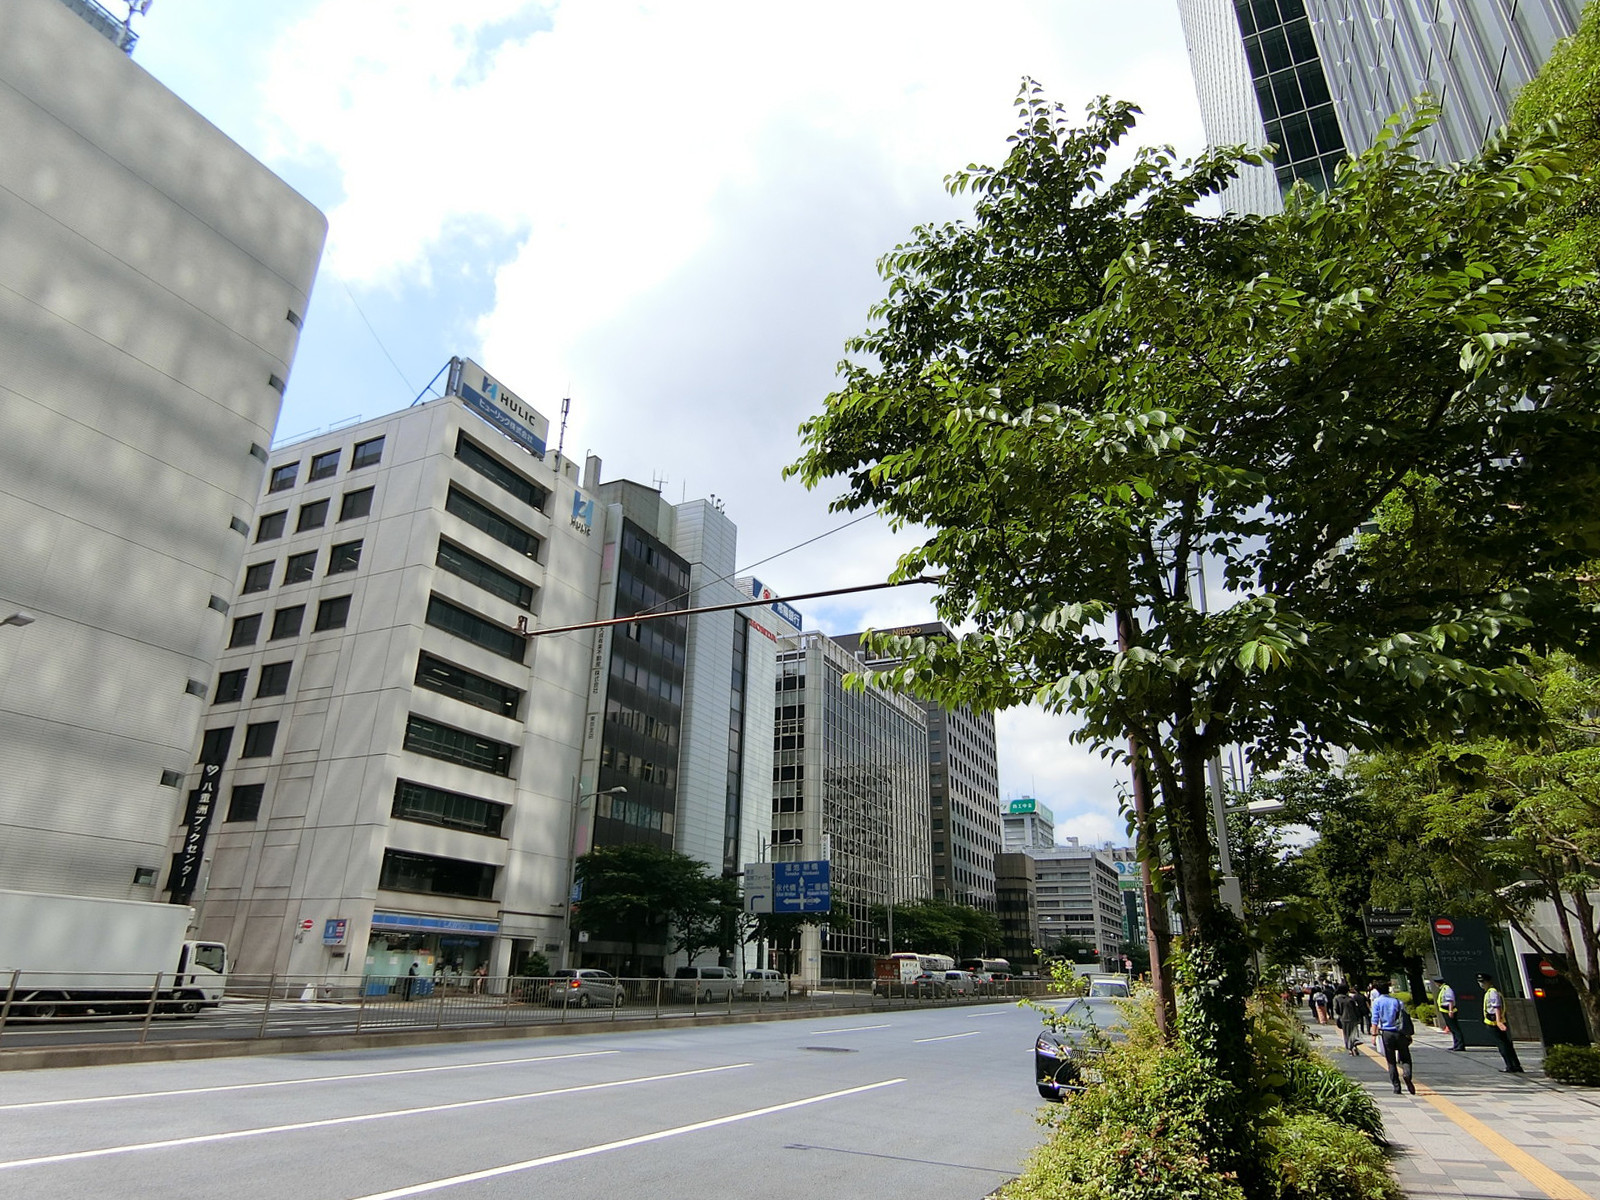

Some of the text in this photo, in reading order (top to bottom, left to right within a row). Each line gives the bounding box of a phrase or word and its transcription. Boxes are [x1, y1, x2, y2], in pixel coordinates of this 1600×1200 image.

[479, 399, 534, 443] ヒューリック株式会社
[500, 393, 536, 427] HULIC
[570, 517, 592, 536] HULIC
[892, 626, 922, 636] Nittobo
[180, 782, 213, 887] 八重洲ブックセンター
